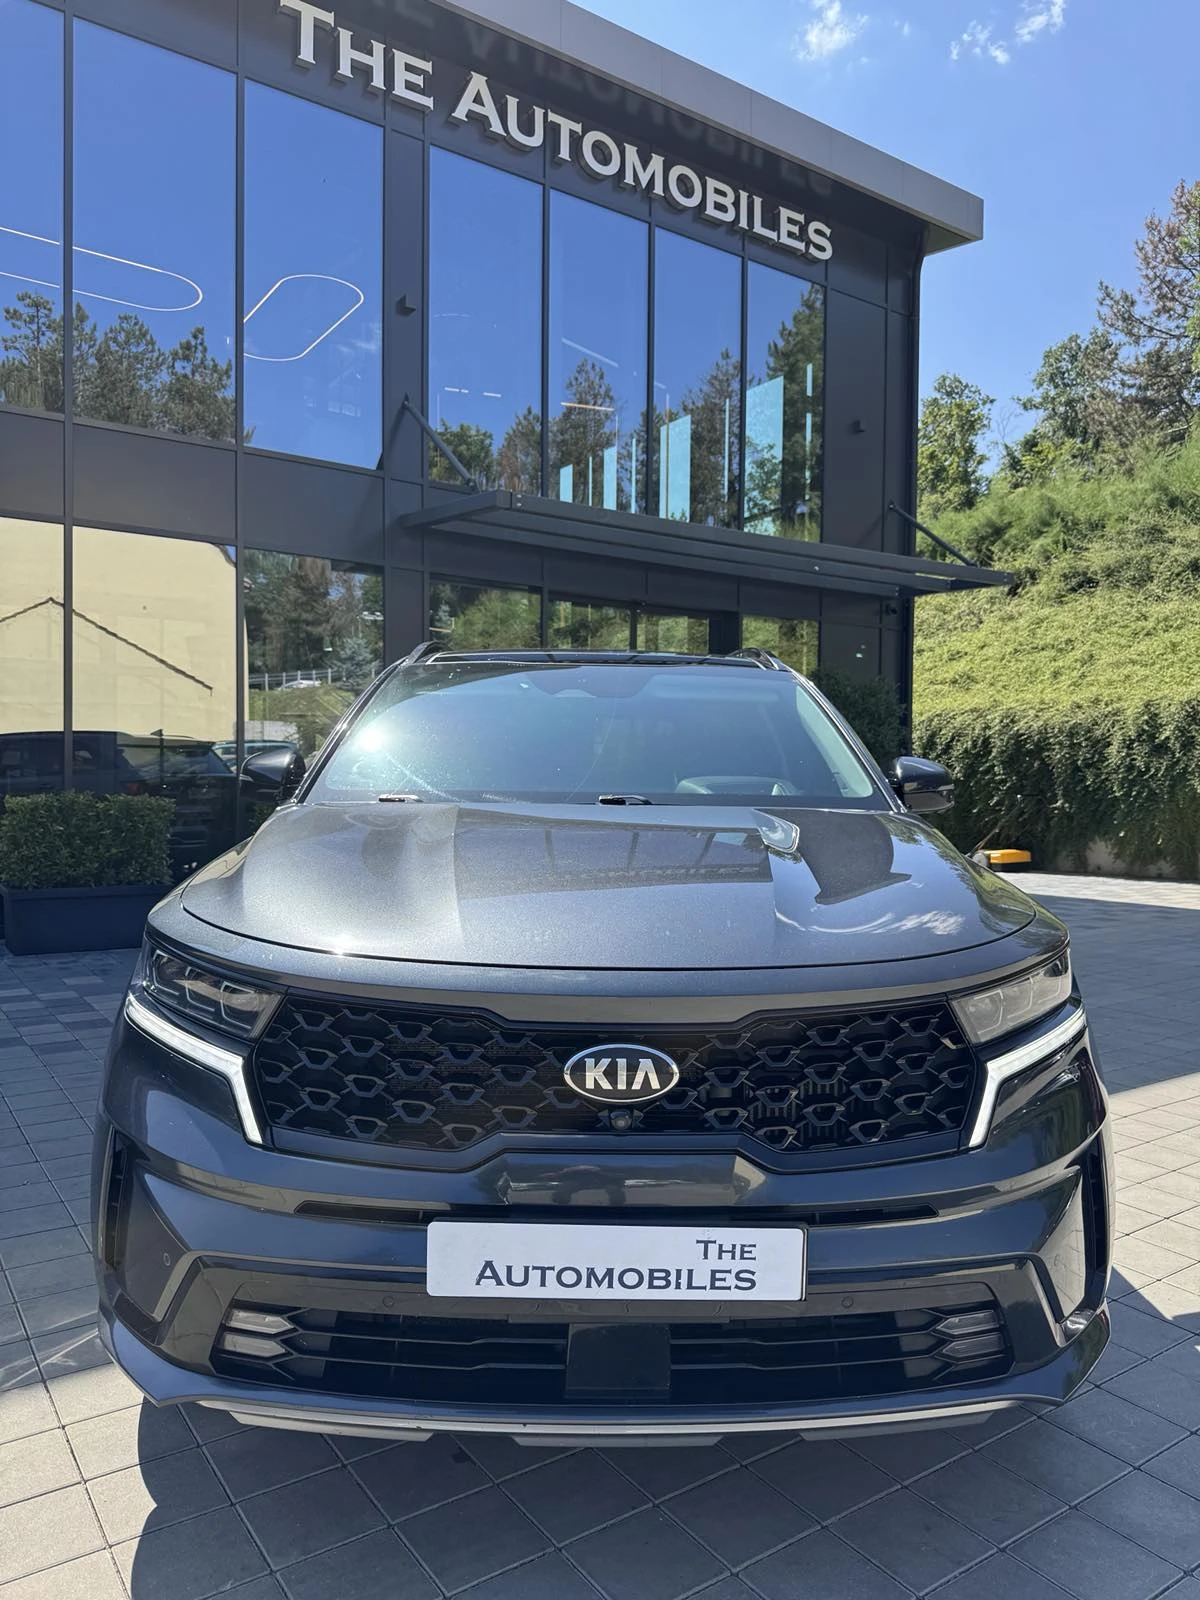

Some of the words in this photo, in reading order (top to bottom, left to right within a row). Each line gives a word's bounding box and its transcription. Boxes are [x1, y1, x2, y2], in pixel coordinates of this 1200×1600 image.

[279, 0, 434, 110] THE
[451, 72, 833, 261] AUTOMOBILES
[584, 1058, 661, 1090] KIA
[695, 1239, 757, 1261] THE
[475, 1260, 757, 1291] AUTOMOBILES
